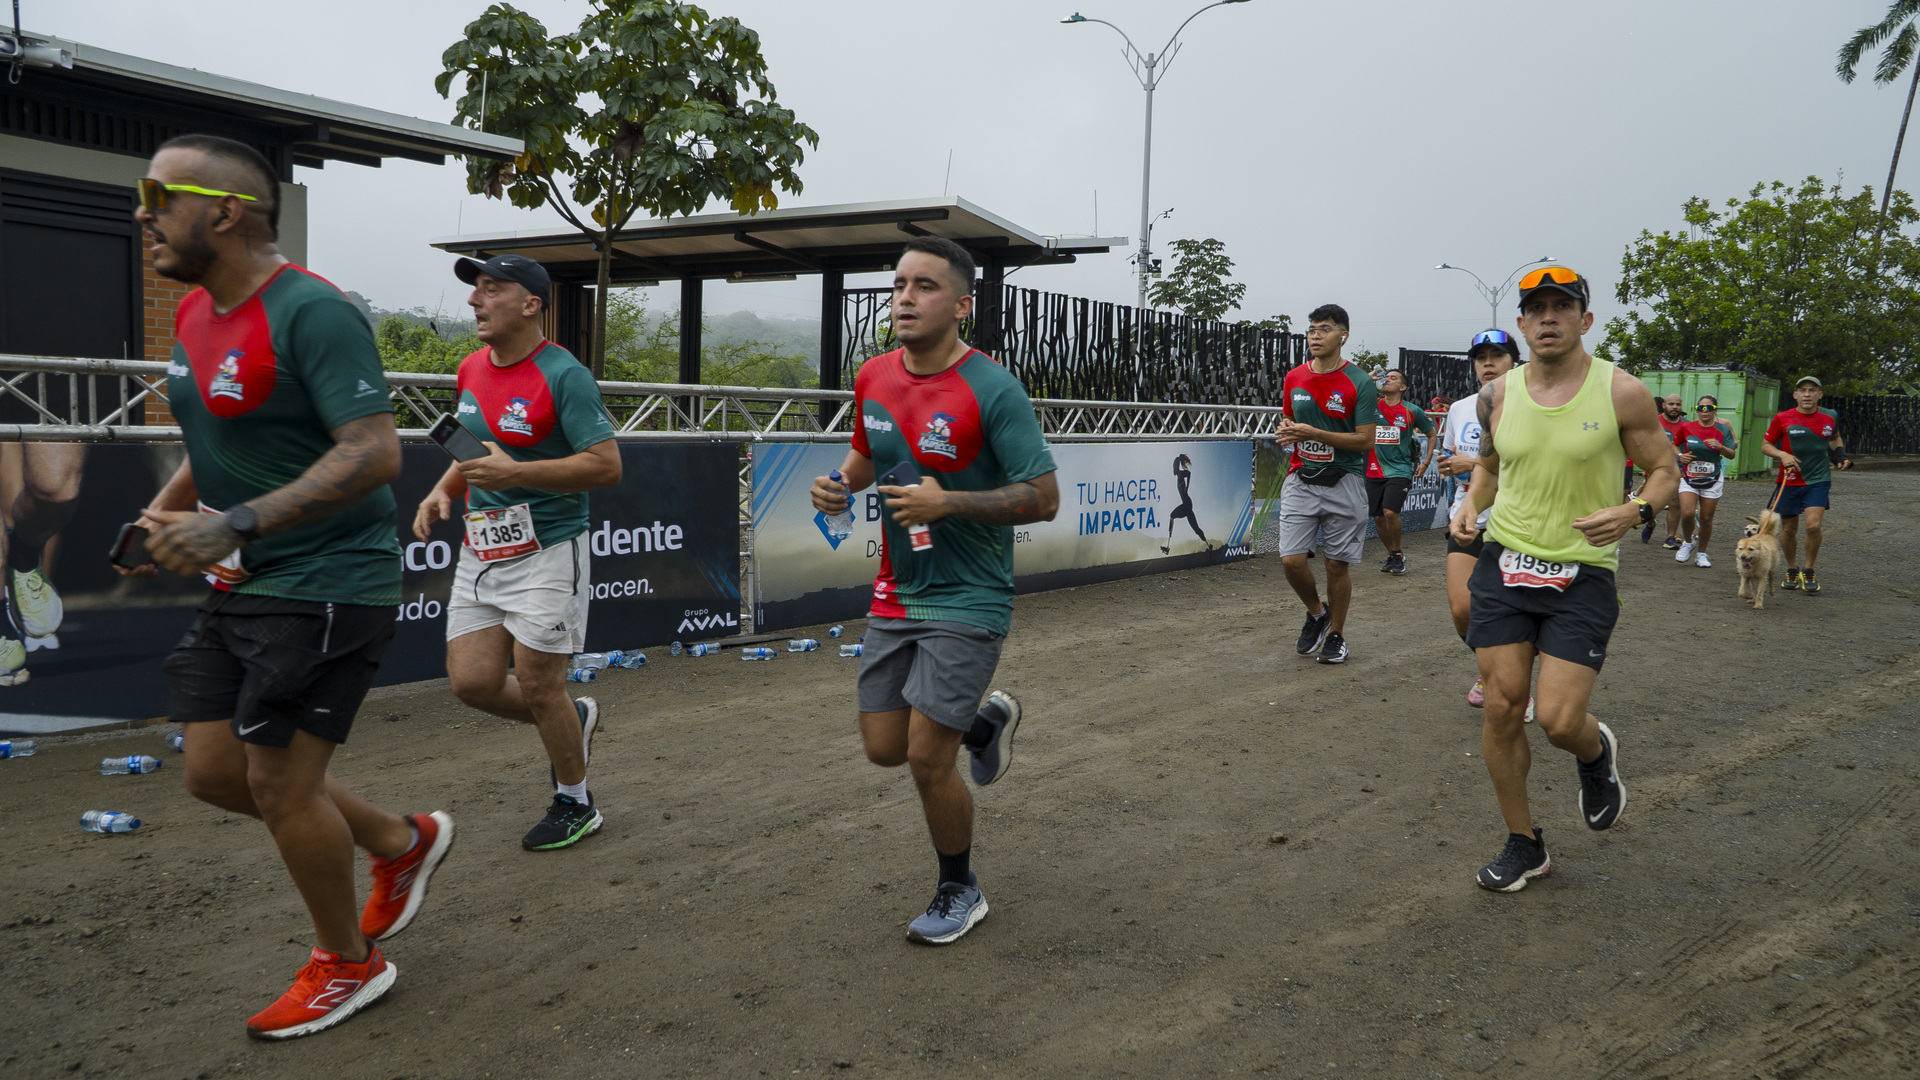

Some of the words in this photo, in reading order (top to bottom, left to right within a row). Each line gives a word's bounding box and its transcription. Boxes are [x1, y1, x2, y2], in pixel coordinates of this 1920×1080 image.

[1377, 431, 1395, 439] 2235
[1301, 441, 1327, 453] 1204
[1077, 483, 1098, 505] TU
[1105, 479, 1161, 503] HACER,
[1401, 493, 1438, 512] MPACTA.
[1079, 507, 1161, 536] IMPACTA.
[480, 523, 523, 546] 1385
[1225, 546, 1248, 557] AVAL
[1514, 553, 1563, 576] 1959
[685, 608, 709, 617] Grupo
[677, 613, 738, 634] AVAL
